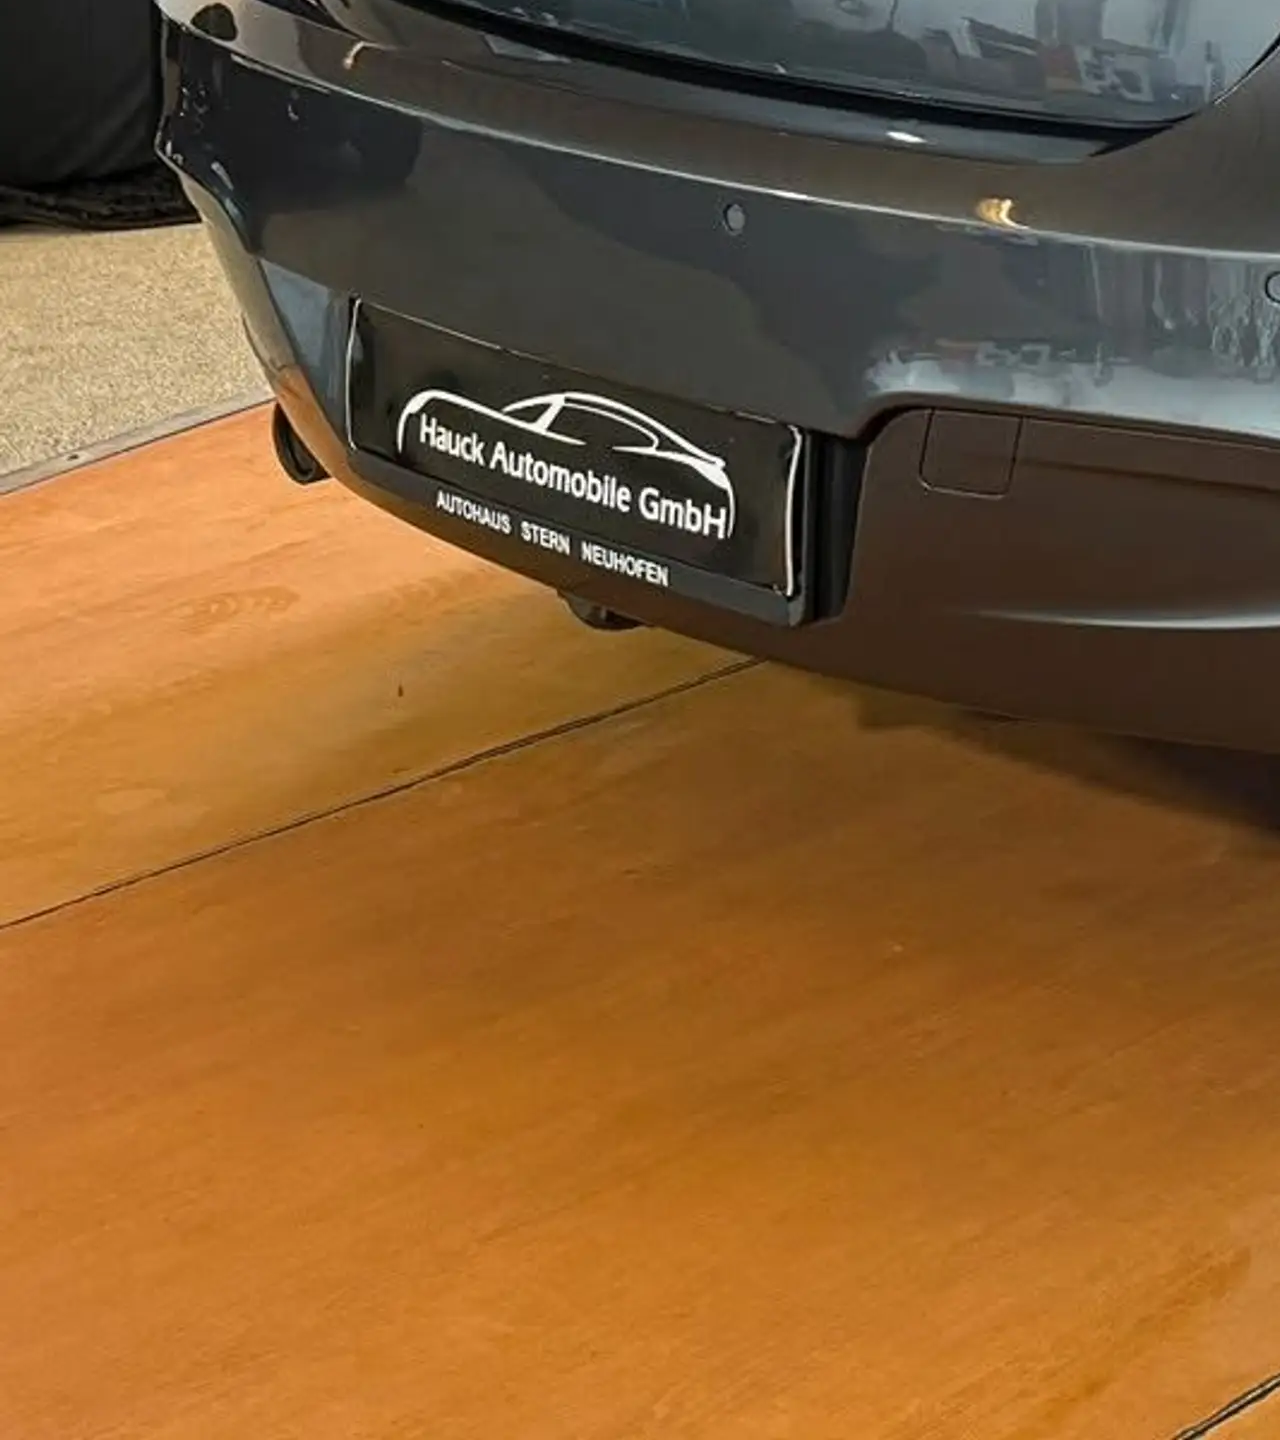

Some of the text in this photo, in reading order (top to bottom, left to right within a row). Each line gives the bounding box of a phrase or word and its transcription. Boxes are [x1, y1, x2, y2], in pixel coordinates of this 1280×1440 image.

[420, 412, 728, 540] Hauck Automobile GmbH
[436, 490, 669, 587] AUTOHAUS STERN NEUHOFEN
